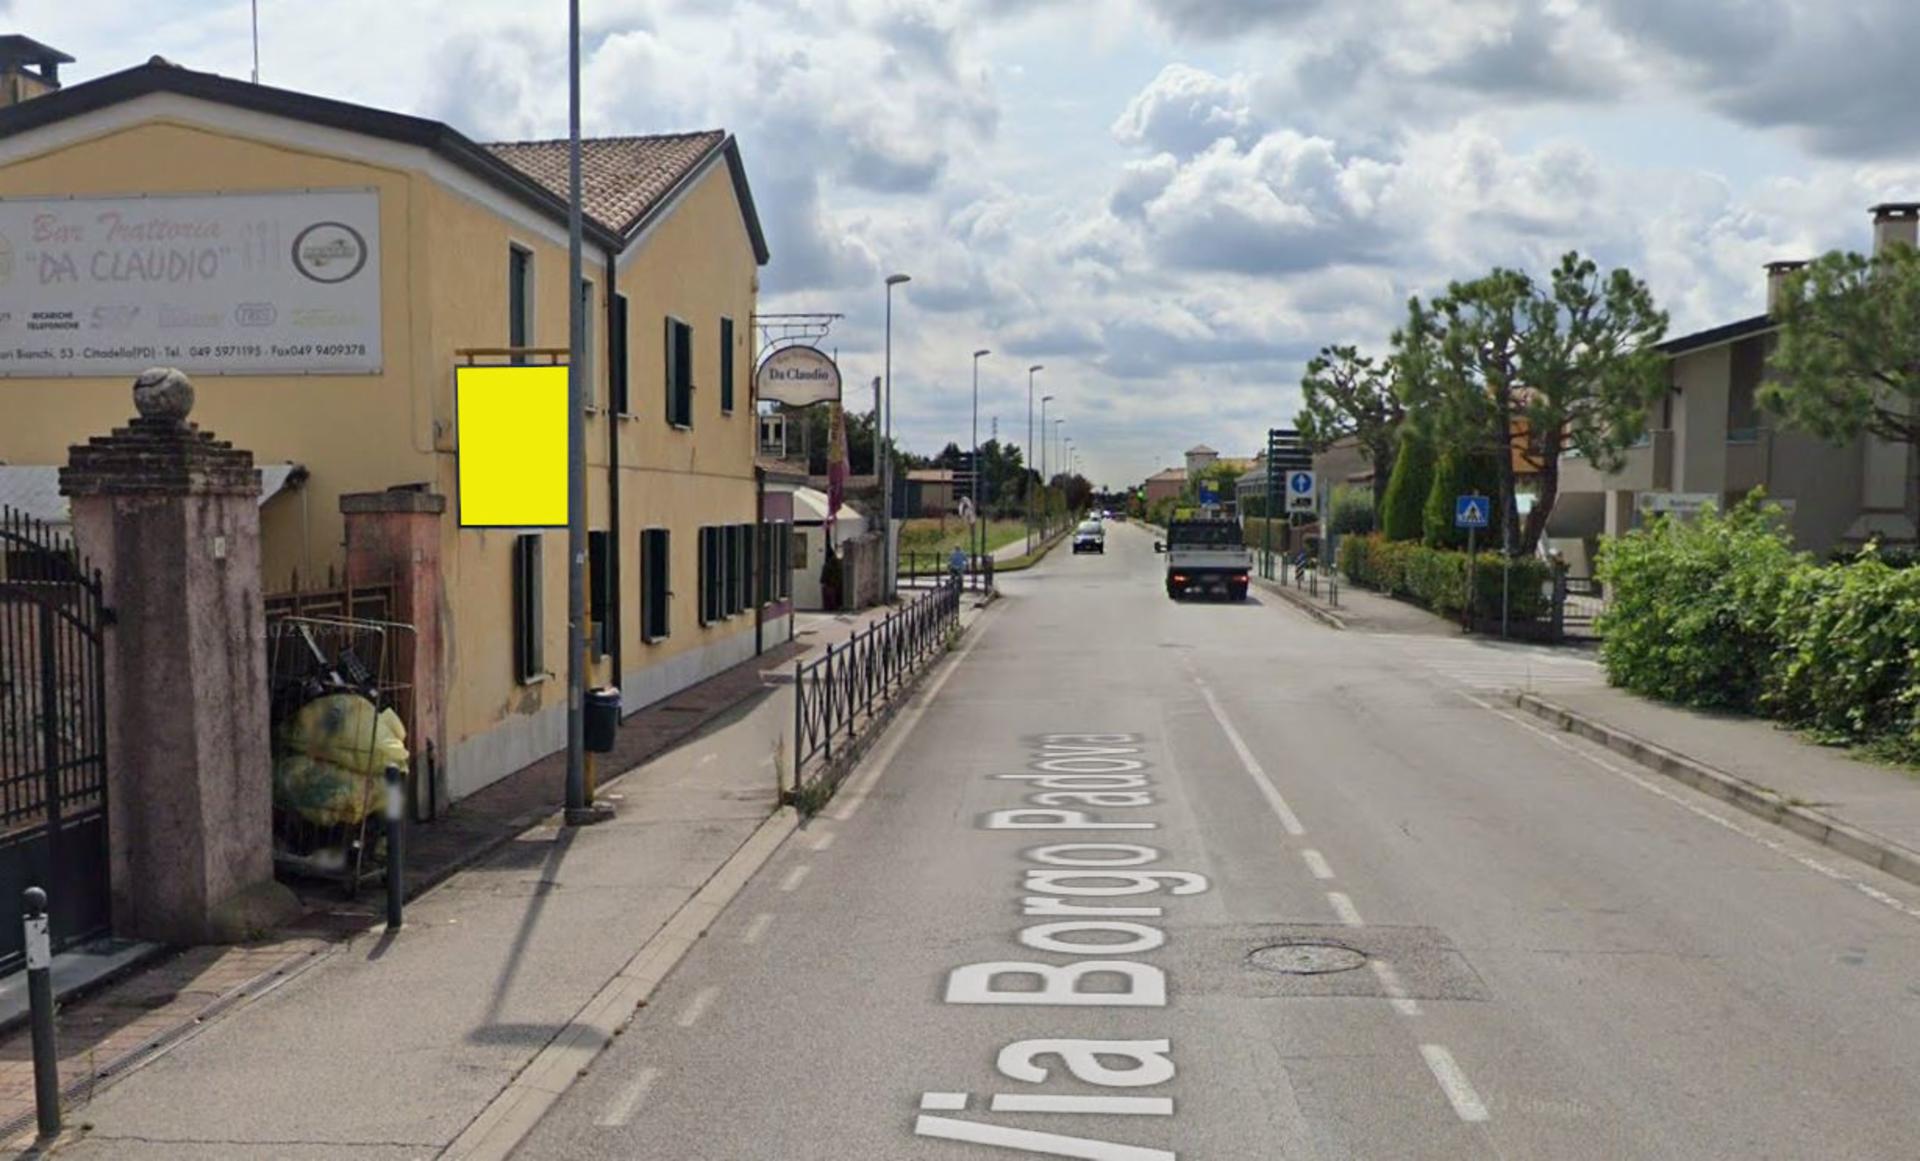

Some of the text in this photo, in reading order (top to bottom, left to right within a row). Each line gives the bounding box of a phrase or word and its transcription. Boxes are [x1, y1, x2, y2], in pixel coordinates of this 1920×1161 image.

[33, 209, 222, 243] Bar Trattoria
[27, 319, 80, 331] TELEFONICHE
[60, 347, 74, 359] 53
[189, 345, 212, 358] 049
[214, 344, 262, 358] 5971195
[315, 343, 366, 356] 9409378
[769, 367, 830, 381] Da Claudio
